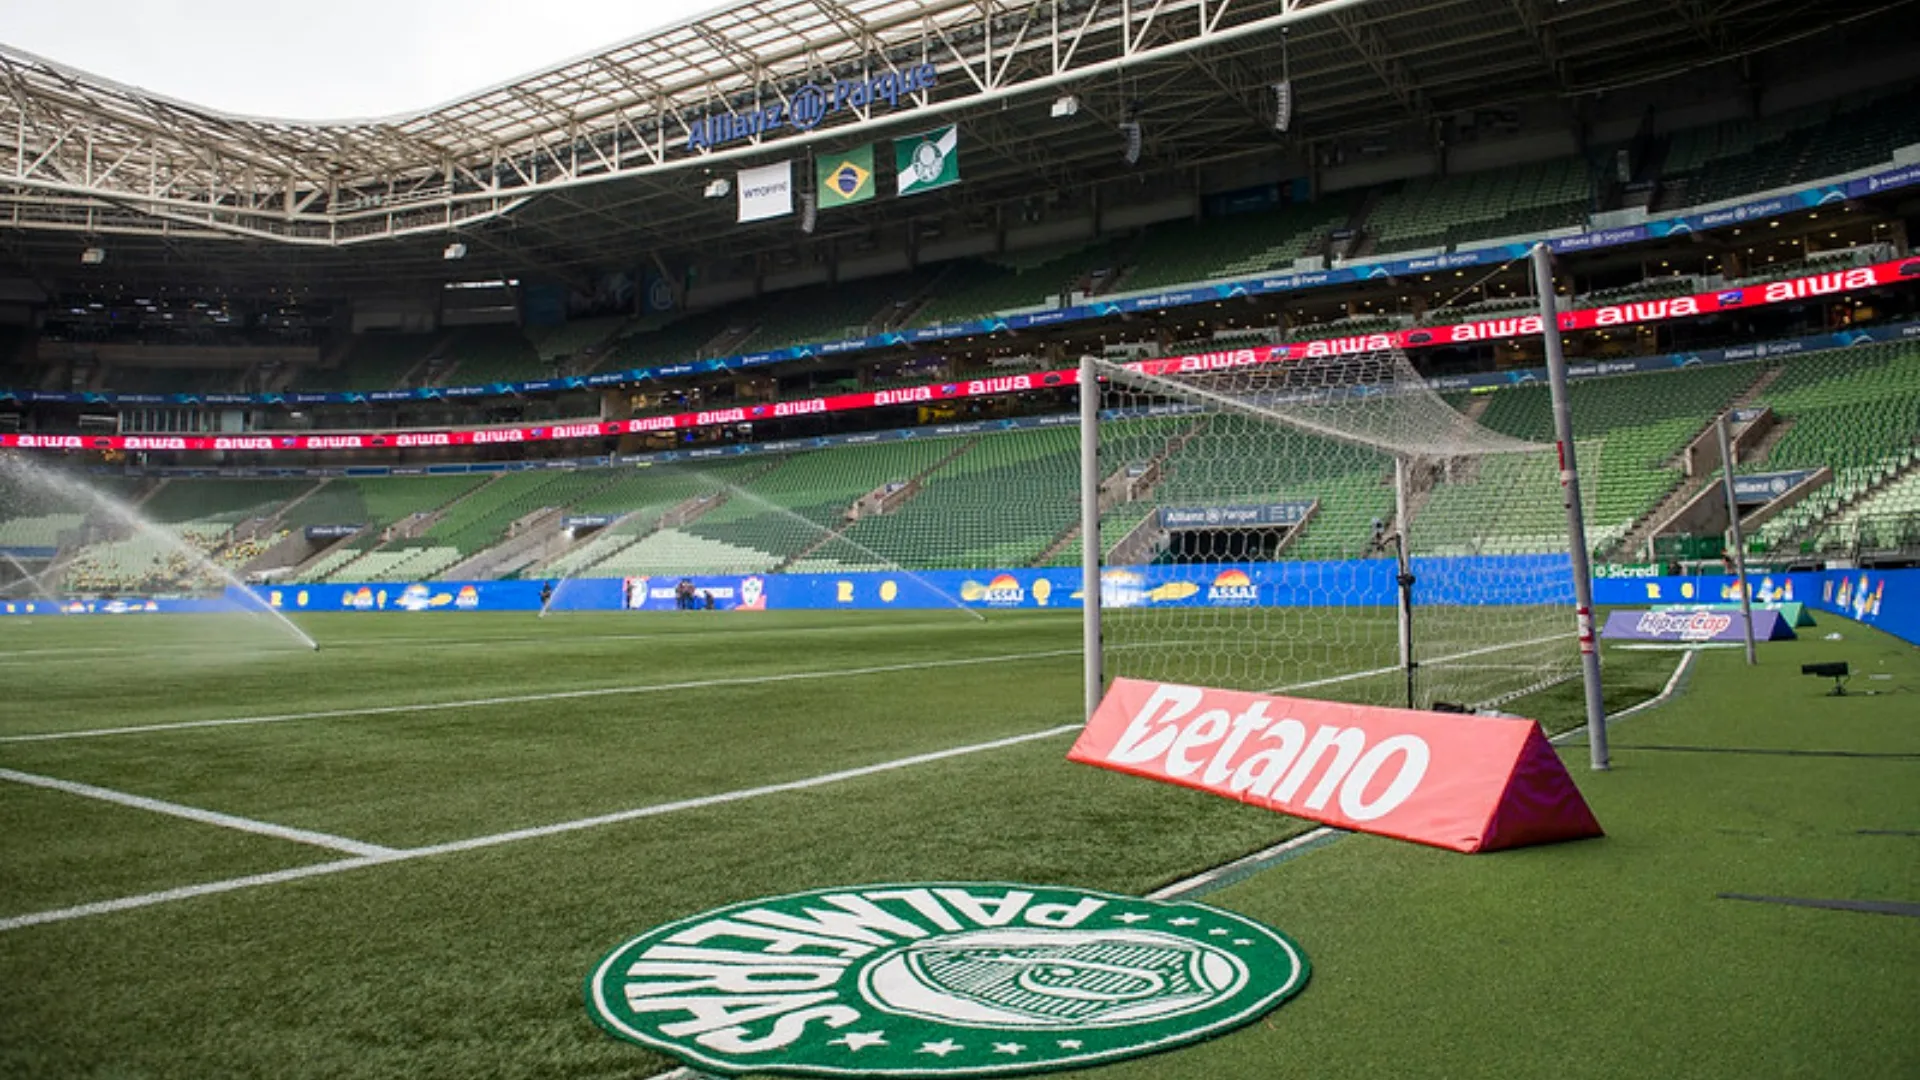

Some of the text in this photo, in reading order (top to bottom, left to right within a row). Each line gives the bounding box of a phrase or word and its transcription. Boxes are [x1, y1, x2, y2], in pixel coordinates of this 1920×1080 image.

[687, 63, 937, 149] Allianz Parque
[1765, 267, 1878, 303] aiwa
[1595, 295, 1700, 326] aiwa
[1451, 315, 1545, 342] aiwa
[1306, 333, 1393, 358] aiwa
[1181, 348, 1257, 371] aiwa
[968, 376, 1032, 395] aiwa
[874, 387, 932, 406] aiwa
[697, 408, 745, 424] aiwa
[774, 399, 827, 416] aiwa
[552, 424, 600, 438] aiwa
[629, 416, 676, 432] aiwa
[17, 434, 82, 448] aiwa
[125, 436, 186, 450] aiwa
[214, 436, 273, 450] aiwa
[307, 435, 362, 448] aiwa
[396, 434, 450, 446] aiwa
[473, 429, 525, 443] aiwa
[1608, 563, 1659, 577] Sicredi
[1106, 683, 1431, 822] Betano
[624, 886, 1107, 1054] PALMEIRAS
